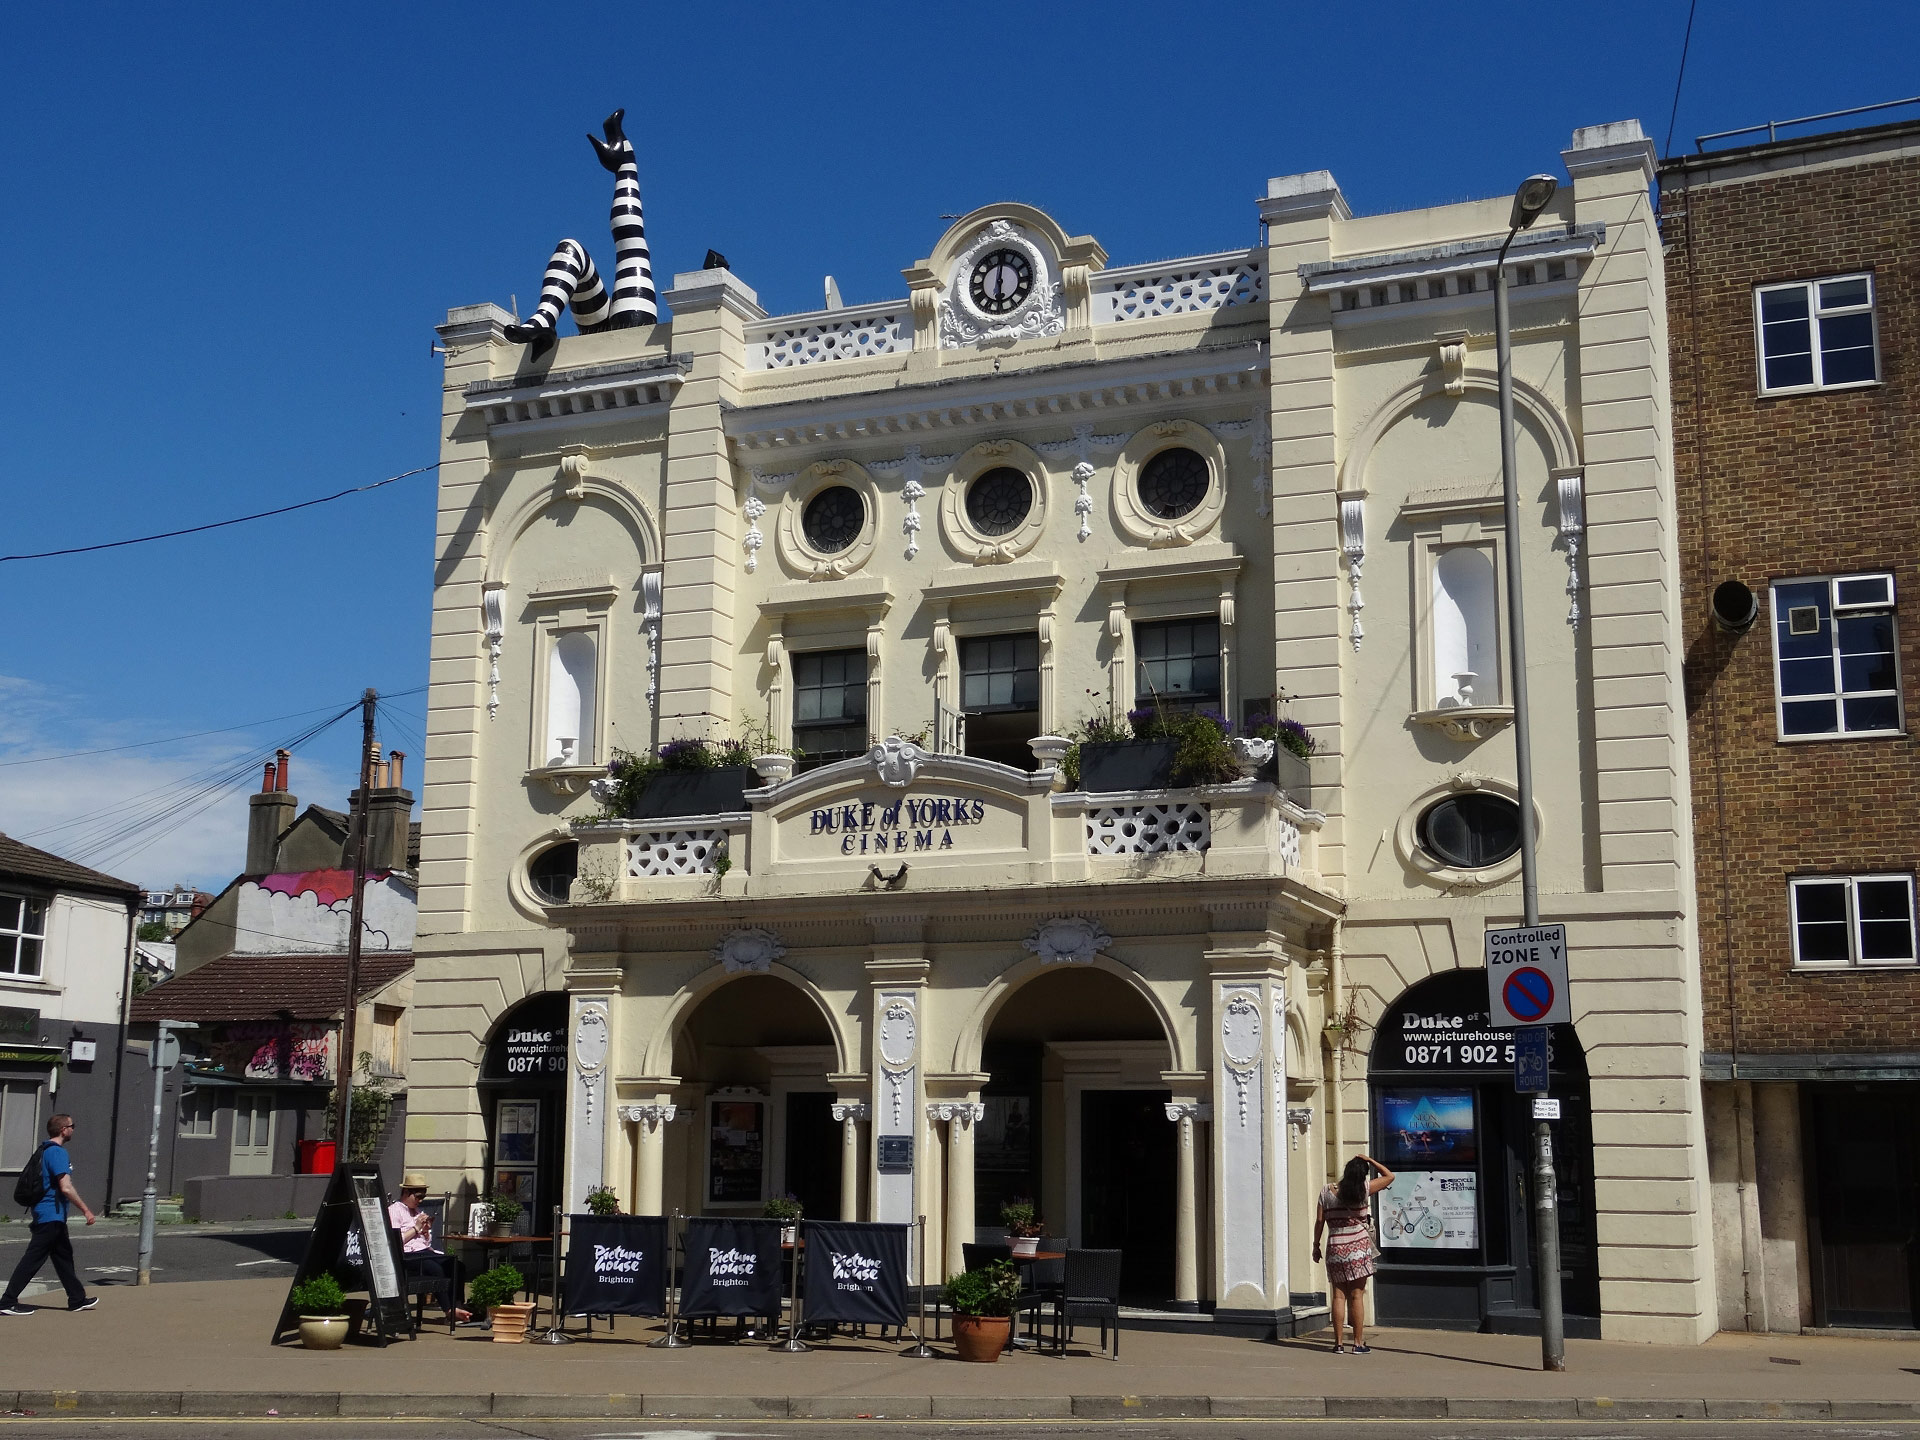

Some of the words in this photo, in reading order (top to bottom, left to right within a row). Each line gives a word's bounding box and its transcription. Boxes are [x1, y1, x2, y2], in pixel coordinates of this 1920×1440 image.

[811, 802, 876, 830] DUKE
[883, 800, 902, 825] of
[907, 798, 985, 823] YORKS
[843, 828, 954, 851] CINEMA
[1491, 929, 1560, 946] Controlled
[1491, 947, 1540, 965] ZONE
[1550, 945, 1561, 960] Y
[1402, 1012, 1463, 1029] Duke
[1467, 1012, 1479, 1021] of
[507, 1028, 553, 1043] Duke
[507, 1044, 568, 1055] www.pictureh
[1405, 1046, 1452, 1063] 0871
[1460, 1045, 1498, 1063] 902
[507, 1056, 543, 1072] 0871
[548, 1056, 567, 1072] 90
[1519, 1076, 1544, 1086] ROUTE
[593, 1244, 643, 1261] Picture
[708, 1247, 757, 1264] Picture
[830, 1252, 881, 1268] Picture
[594, 1258, 639, 1273] house
[709, 1260, 754, 1276] house
[833, 1265, 878, 1280] house
[598, 1275, 634, 1284] Brighton
[713, 1278, 749, 1287] Brighton
[837, 1282, 873, 1292] Brighon
